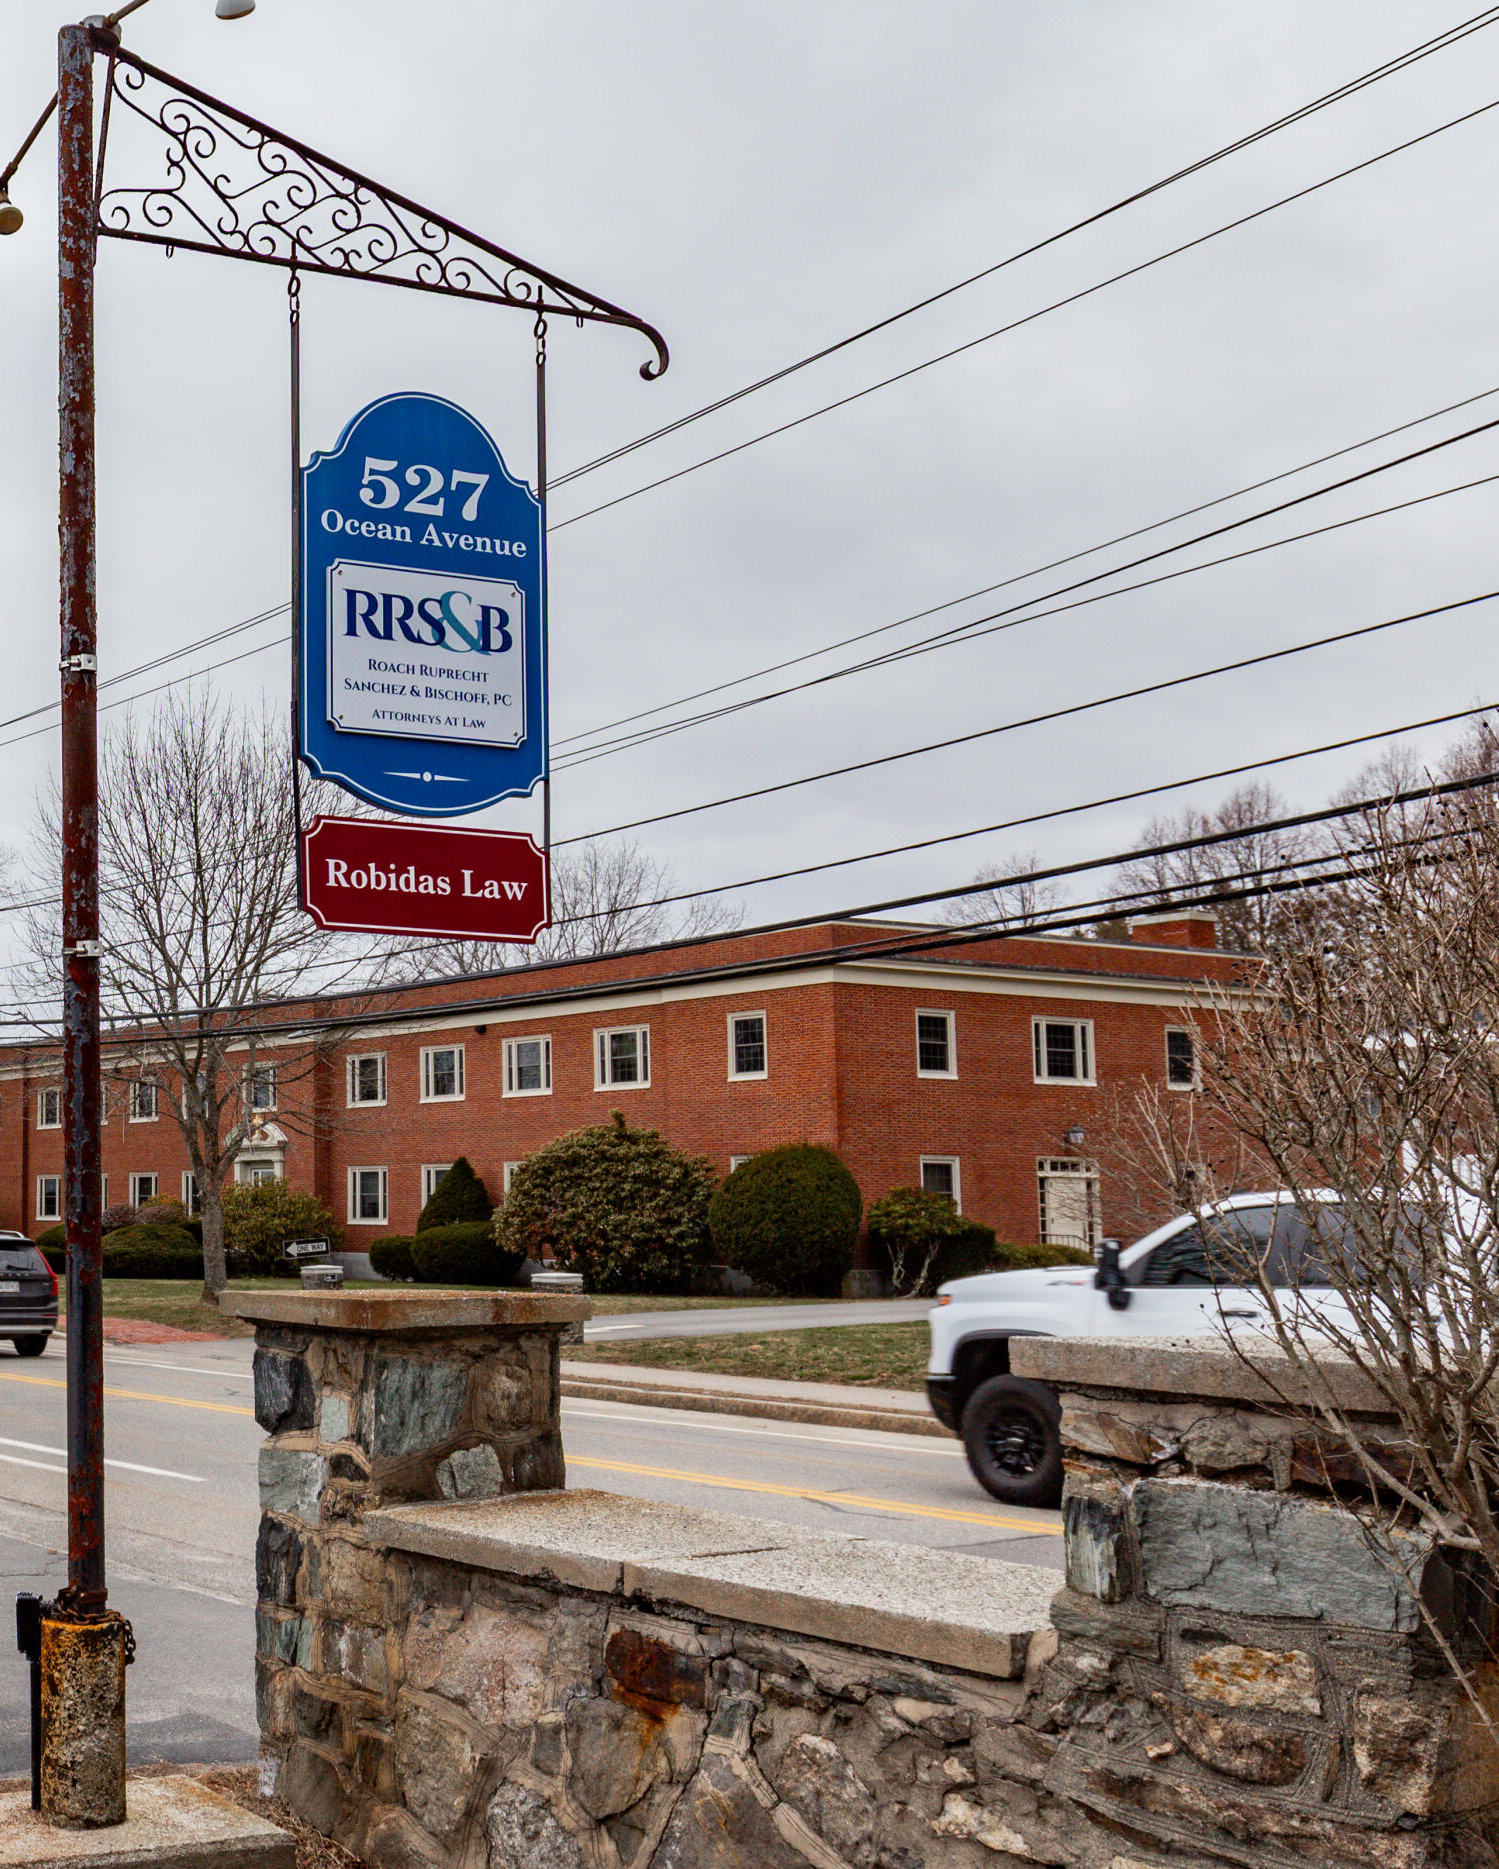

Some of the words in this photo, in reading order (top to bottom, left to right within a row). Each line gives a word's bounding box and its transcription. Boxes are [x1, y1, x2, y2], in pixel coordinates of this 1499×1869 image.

[359, 456, 490, 522] 527
[320, 508, 412, 543] Ocean
[420, 523, 527, 557] Avenue
[341, 588, 513, 656] RRS&B
[368, 659, 415, 675] ROACH
[419, 660, 489, 682] RUPRECHT
[344, 678, 406, 696] SANCHEZ
[410, 686, 421, 697] &
[425, 687, 490, 706] BISCHOFF,
[493, 694, 513, 707] PC
[372, 709, 442, 726] ATTORNEYS
[462, 717, 486, 729] LAW
[325, 858, 451, 896] Robidas
[461, 869, 529, 901] Law
[311, 1243, 324, 1251] WAY
